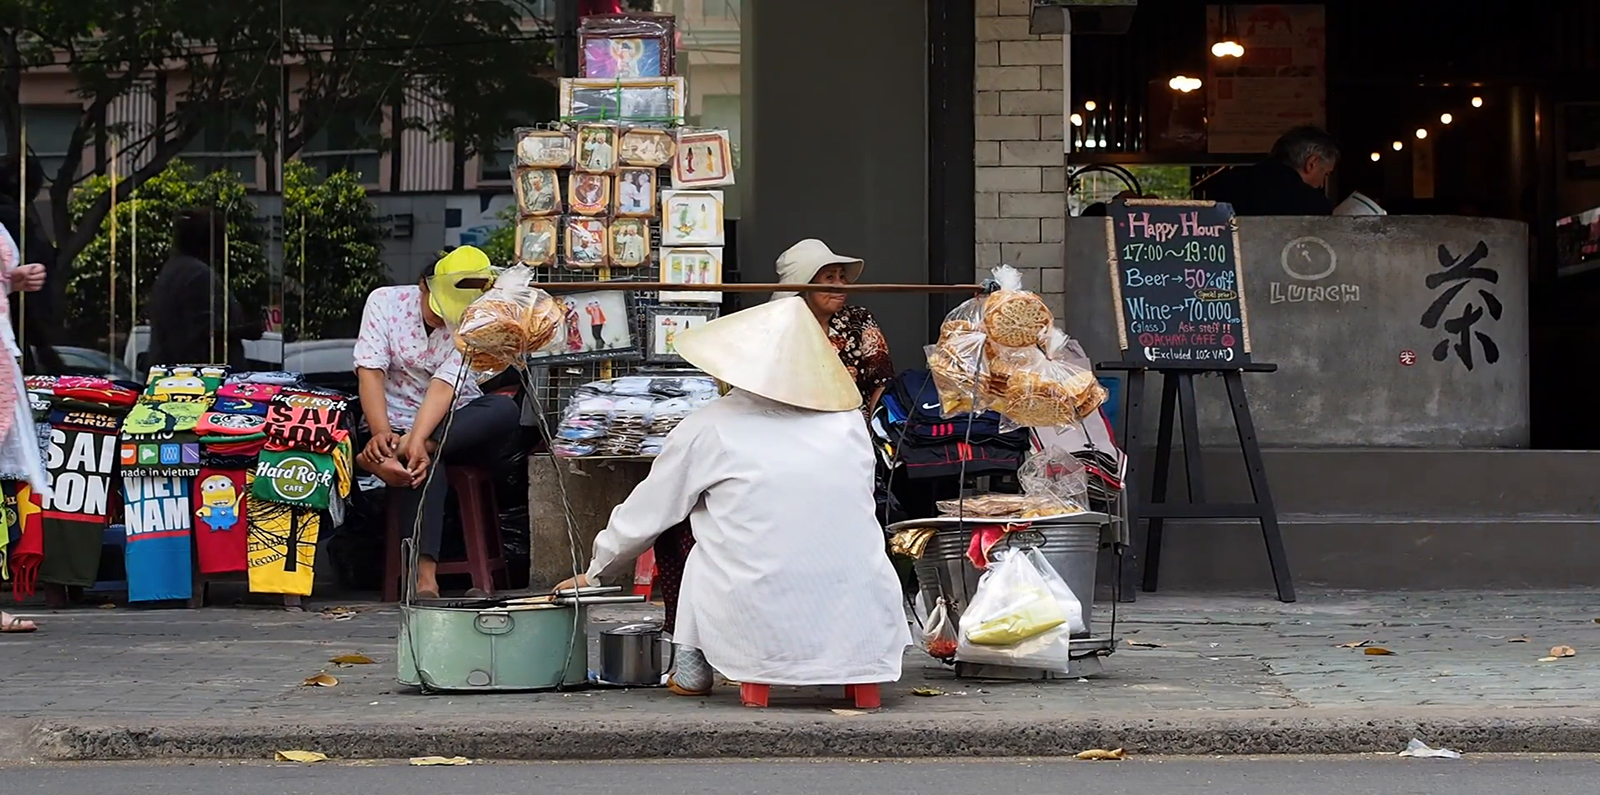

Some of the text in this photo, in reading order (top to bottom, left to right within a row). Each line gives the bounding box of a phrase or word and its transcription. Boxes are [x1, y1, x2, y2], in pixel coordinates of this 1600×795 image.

[1128, 211, 1225, 242] Happy Hour
[1126, 268, 1170, 287] Beer
[1270, 282, 1360, 303] LUNCH
[1126, 297, 1171, 320] Wine
[1420, 240, 1503, 371] 茶
[1178, 321, 1195, 333] Ask
[1191, 334, 1217, 345] CAFE
[63, 416, 117, 428] LARUE
[46, 429, 116, 473] SAI
[149, 468, 159, 476] in
[256, 461, 333, 487] Hard Rock
[283, 484, 304, 493] CAFE
[124, 497, 190, 536] NAM
